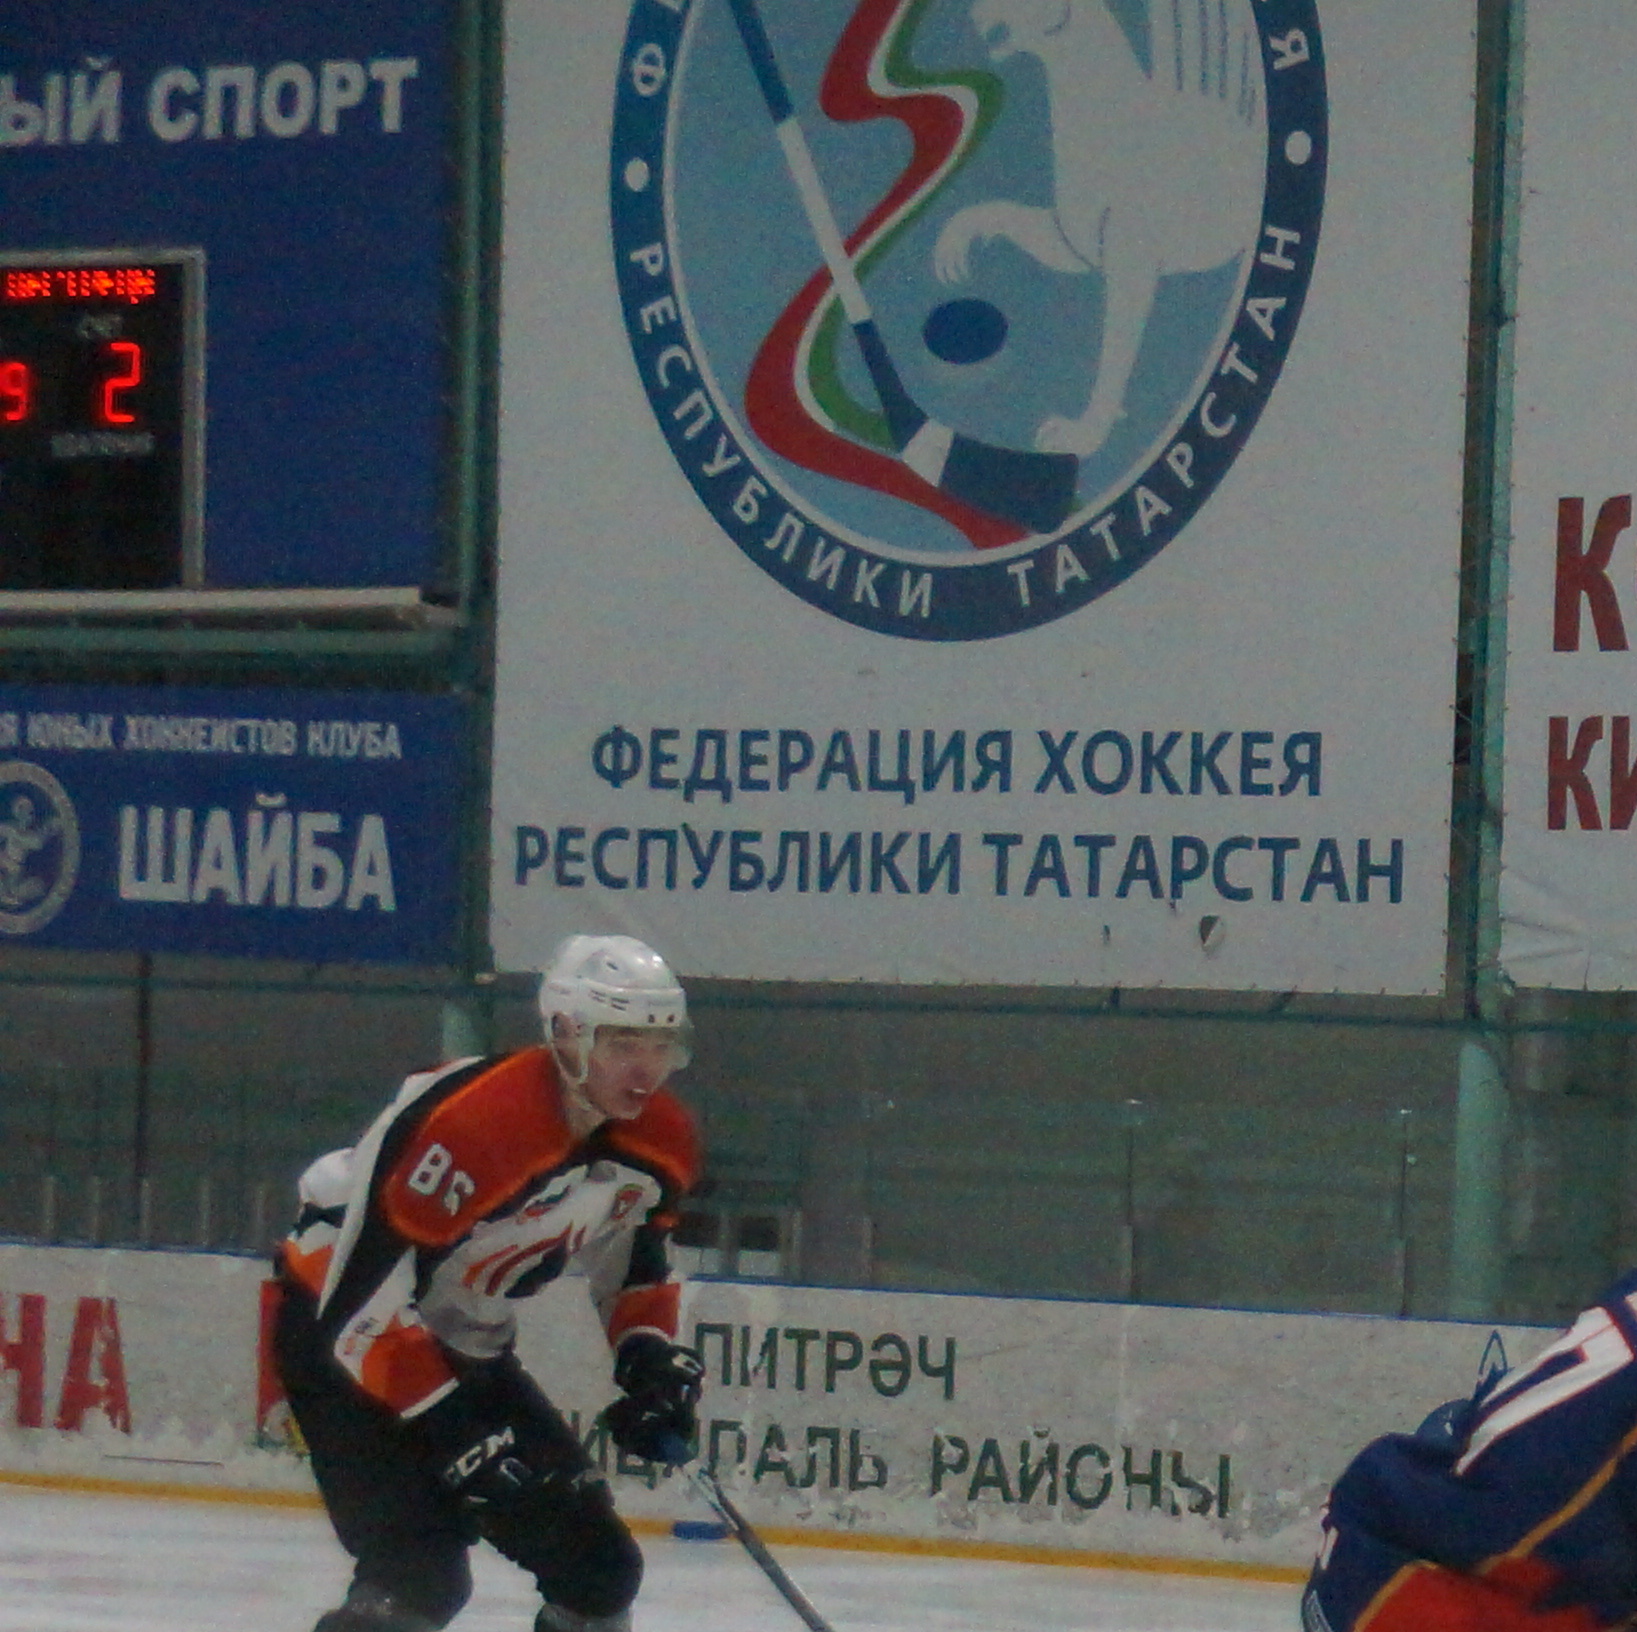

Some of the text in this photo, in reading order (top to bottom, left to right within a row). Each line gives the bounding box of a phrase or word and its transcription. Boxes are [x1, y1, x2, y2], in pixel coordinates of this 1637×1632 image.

[147, 57, 419, 142] СПОРТ
[104, 341, 142, 423] 2
[629, 224, 1303, 620] РЕСПУБЛИКИ ТАТАРСТАН
[307, 720, 401, 760] КЛУБА
[591, 724, 1323, 804] ФЕДЕРАЦИЯ ХОККЕЯ
[118, 791, 398, 912] ШАЙБА
[514, 823, 1403, 904] РЕСПУБЛИКИ ТАТАРСТАН
[694, 1322, 957, 1400] ПИТРӘЧ
[930, 1427, 1231, 1520] РАЙОНЫ
